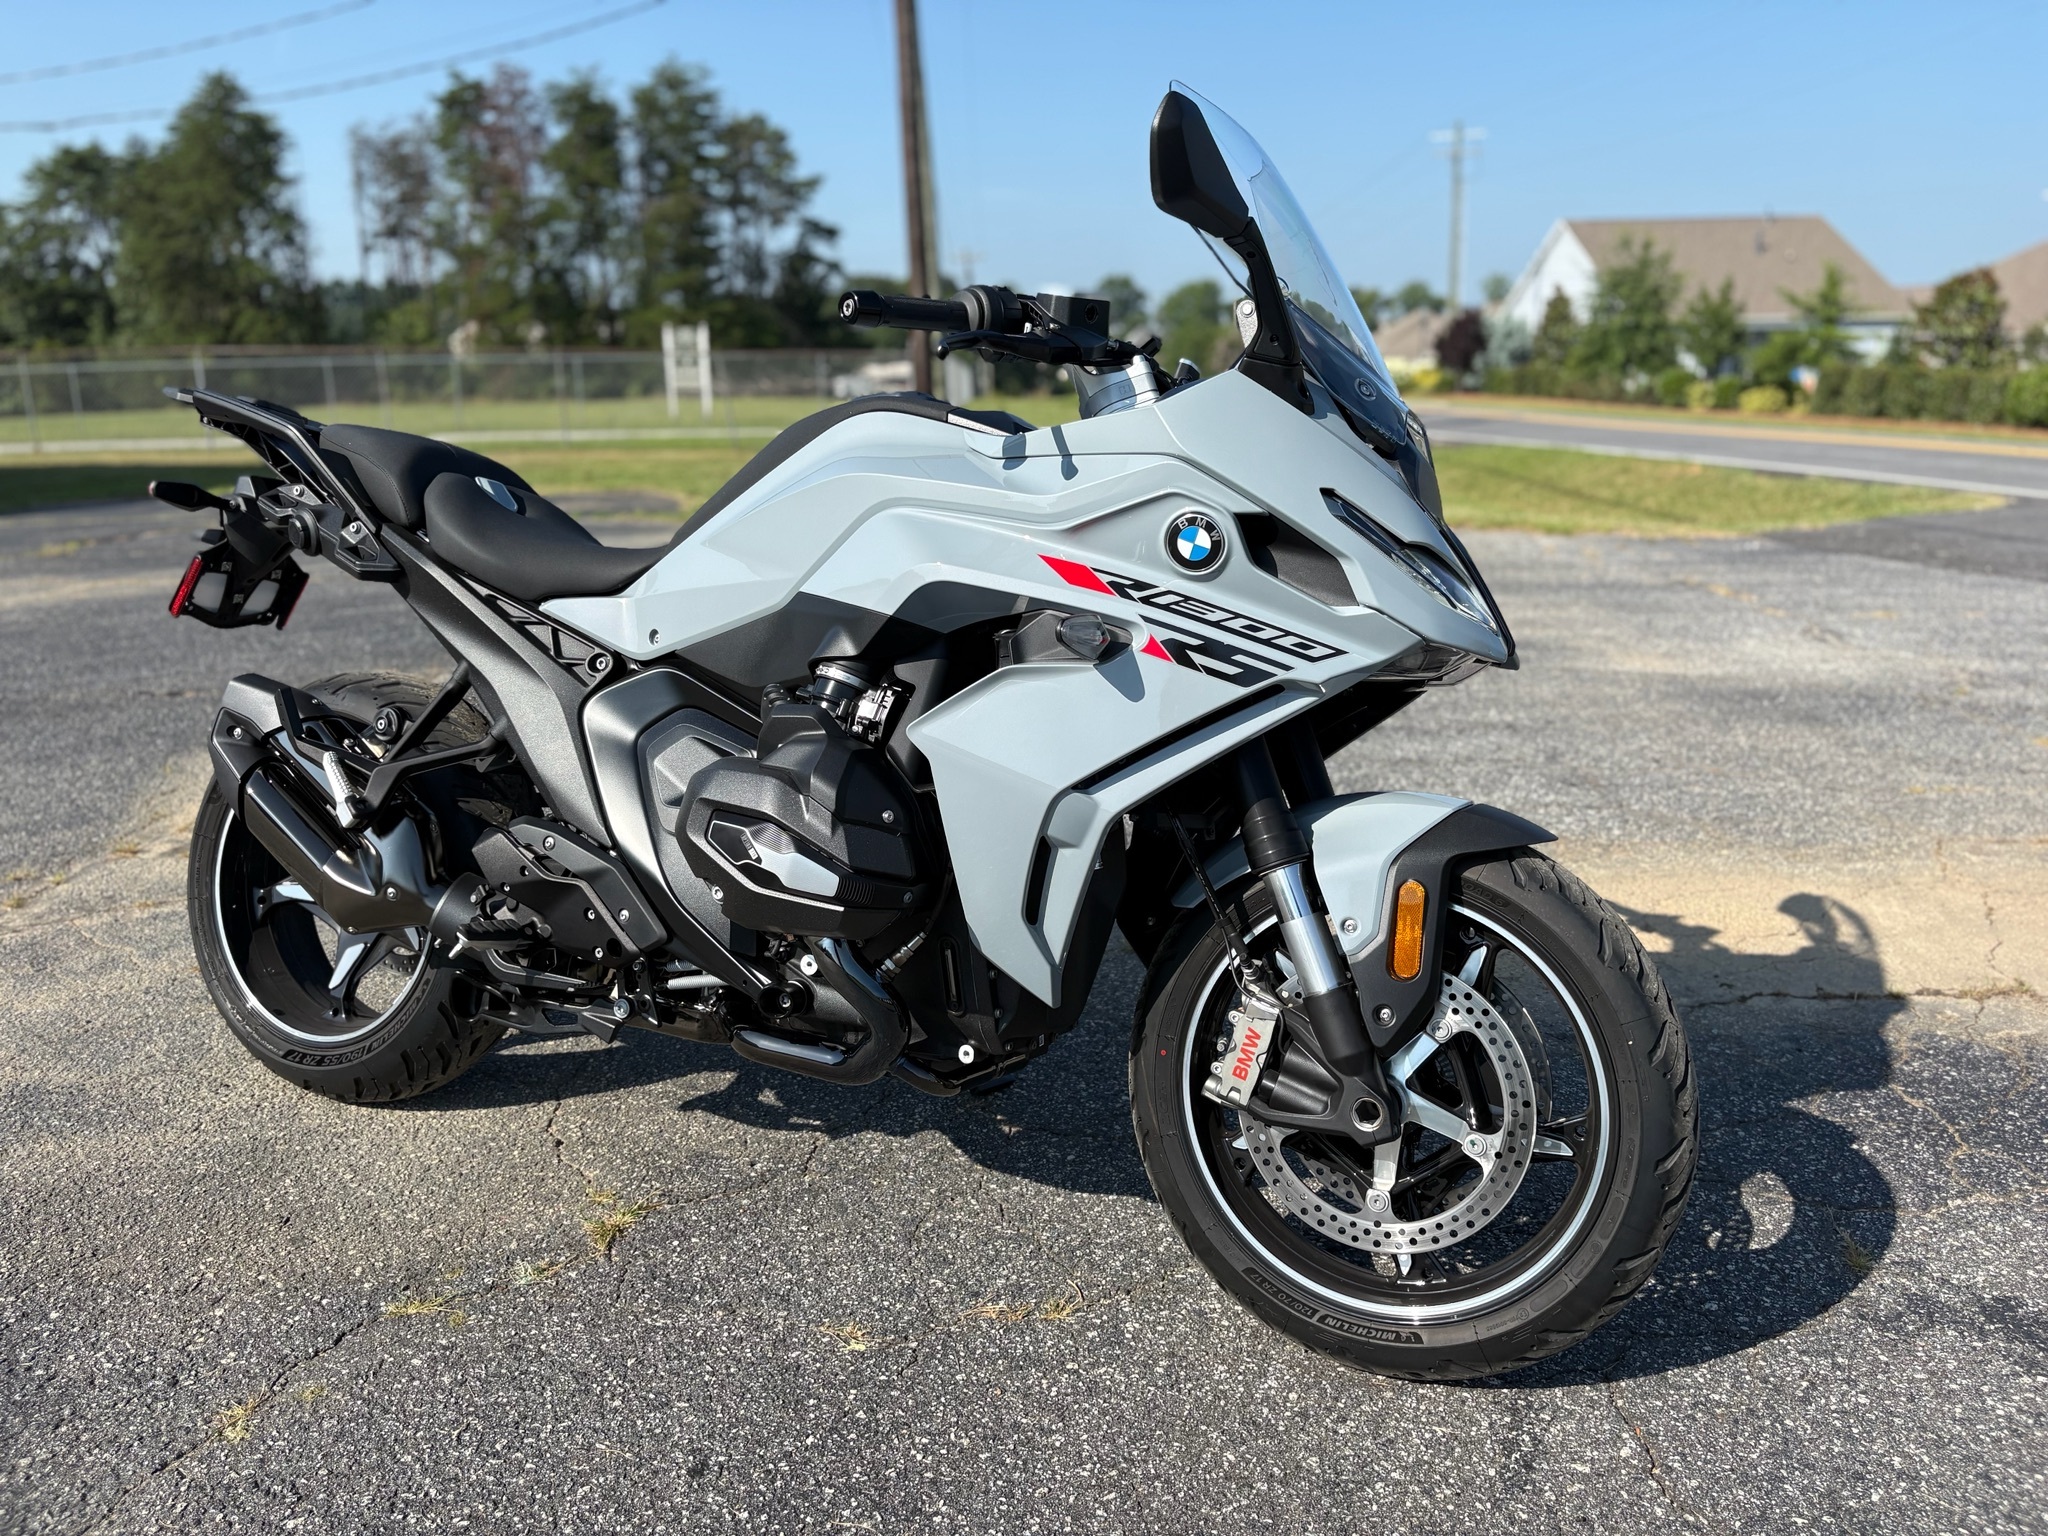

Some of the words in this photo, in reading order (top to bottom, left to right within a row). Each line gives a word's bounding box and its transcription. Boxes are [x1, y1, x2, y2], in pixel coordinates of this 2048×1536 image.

[1177, 517, 1221, 542] BMW
[1461, 881, 1493, 899] OAD
[371, 1000, 418, 1051] MICHELIN
[287, 1052, 302, 1065] 17
[302, 1055, 322, 1067] ZR
[322, 1048, 364, 1067] 190/55
[1231, 1026, 1262, 1081] BMW
[1249, 1272, 1263, 1284] 17
[1262, 1279, 1278, 1295] ZR
[1277, 1292, 1314, 1317] 120/70
[1324, 1315, 1397, 1341] MICHELIN
